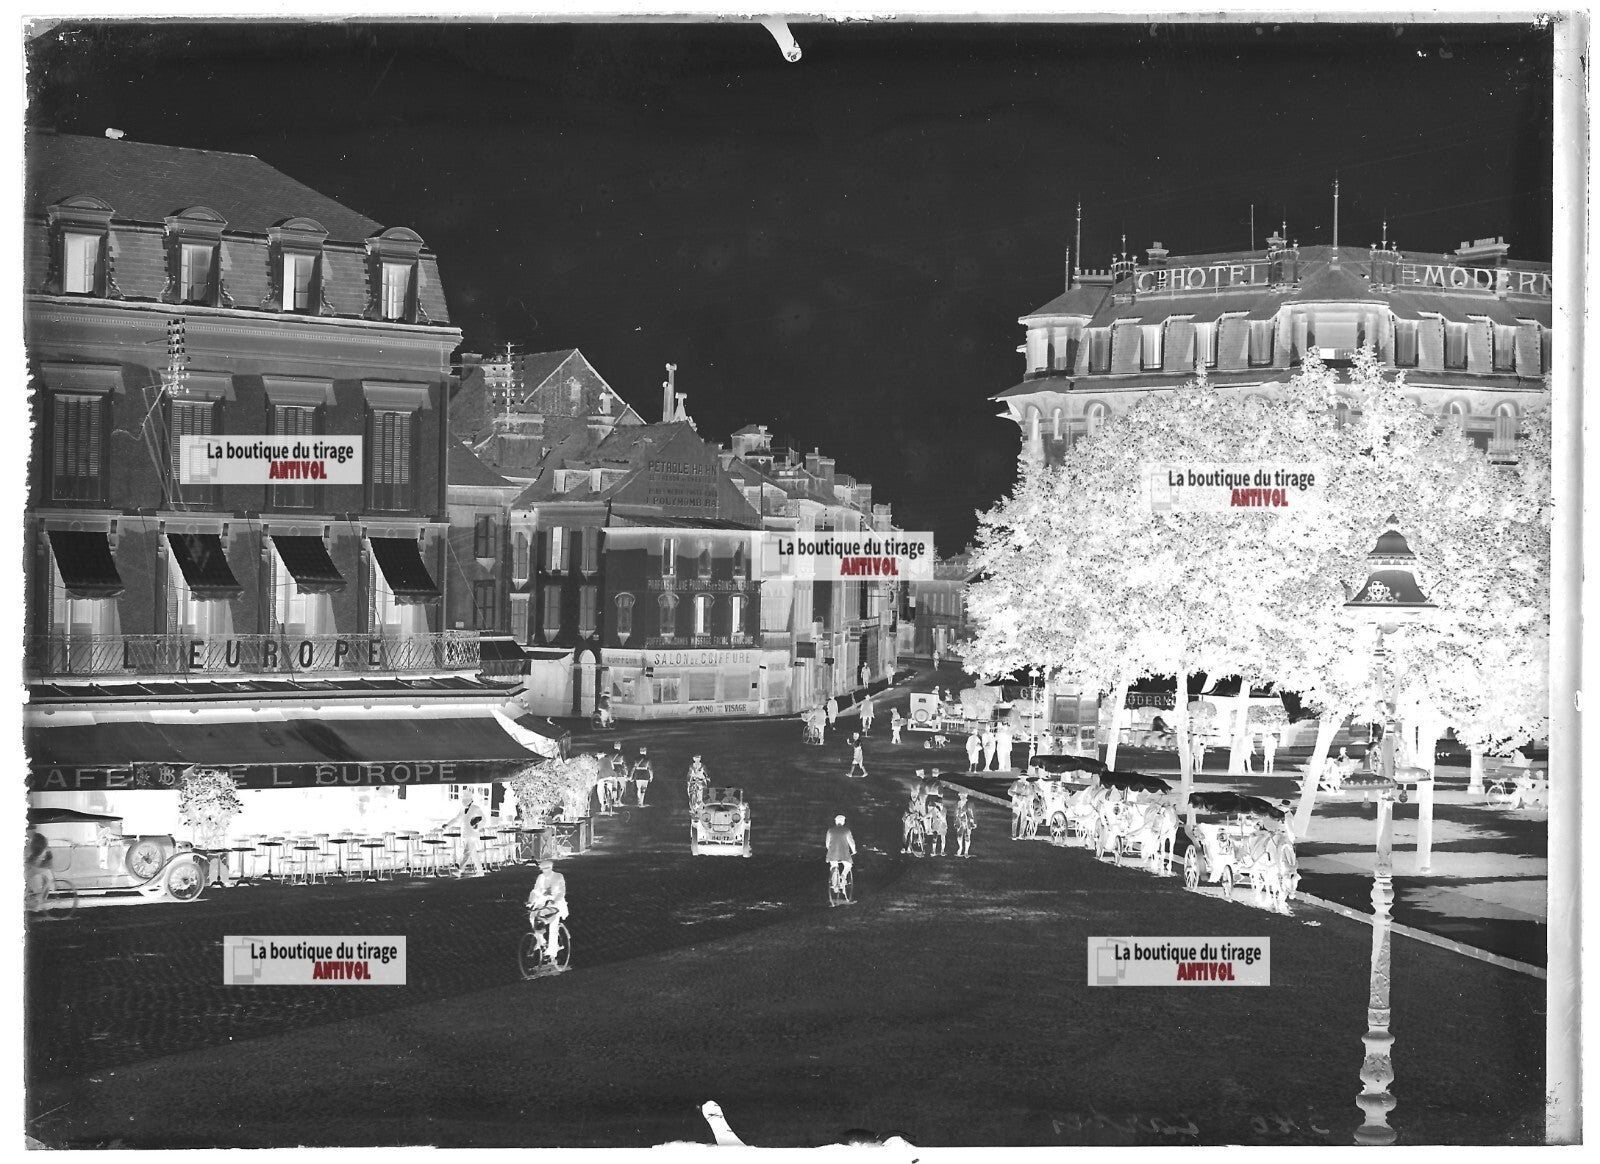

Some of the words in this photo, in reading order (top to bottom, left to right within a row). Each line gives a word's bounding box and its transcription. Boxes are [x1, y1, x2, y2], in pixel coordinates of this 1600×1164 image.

[648, 460, 690, 475] PETROLE
[654, 652, 689, 666] SALON
[724, 703, 747, 713] VISAGE
[27, 767, 133, 788] AFE
